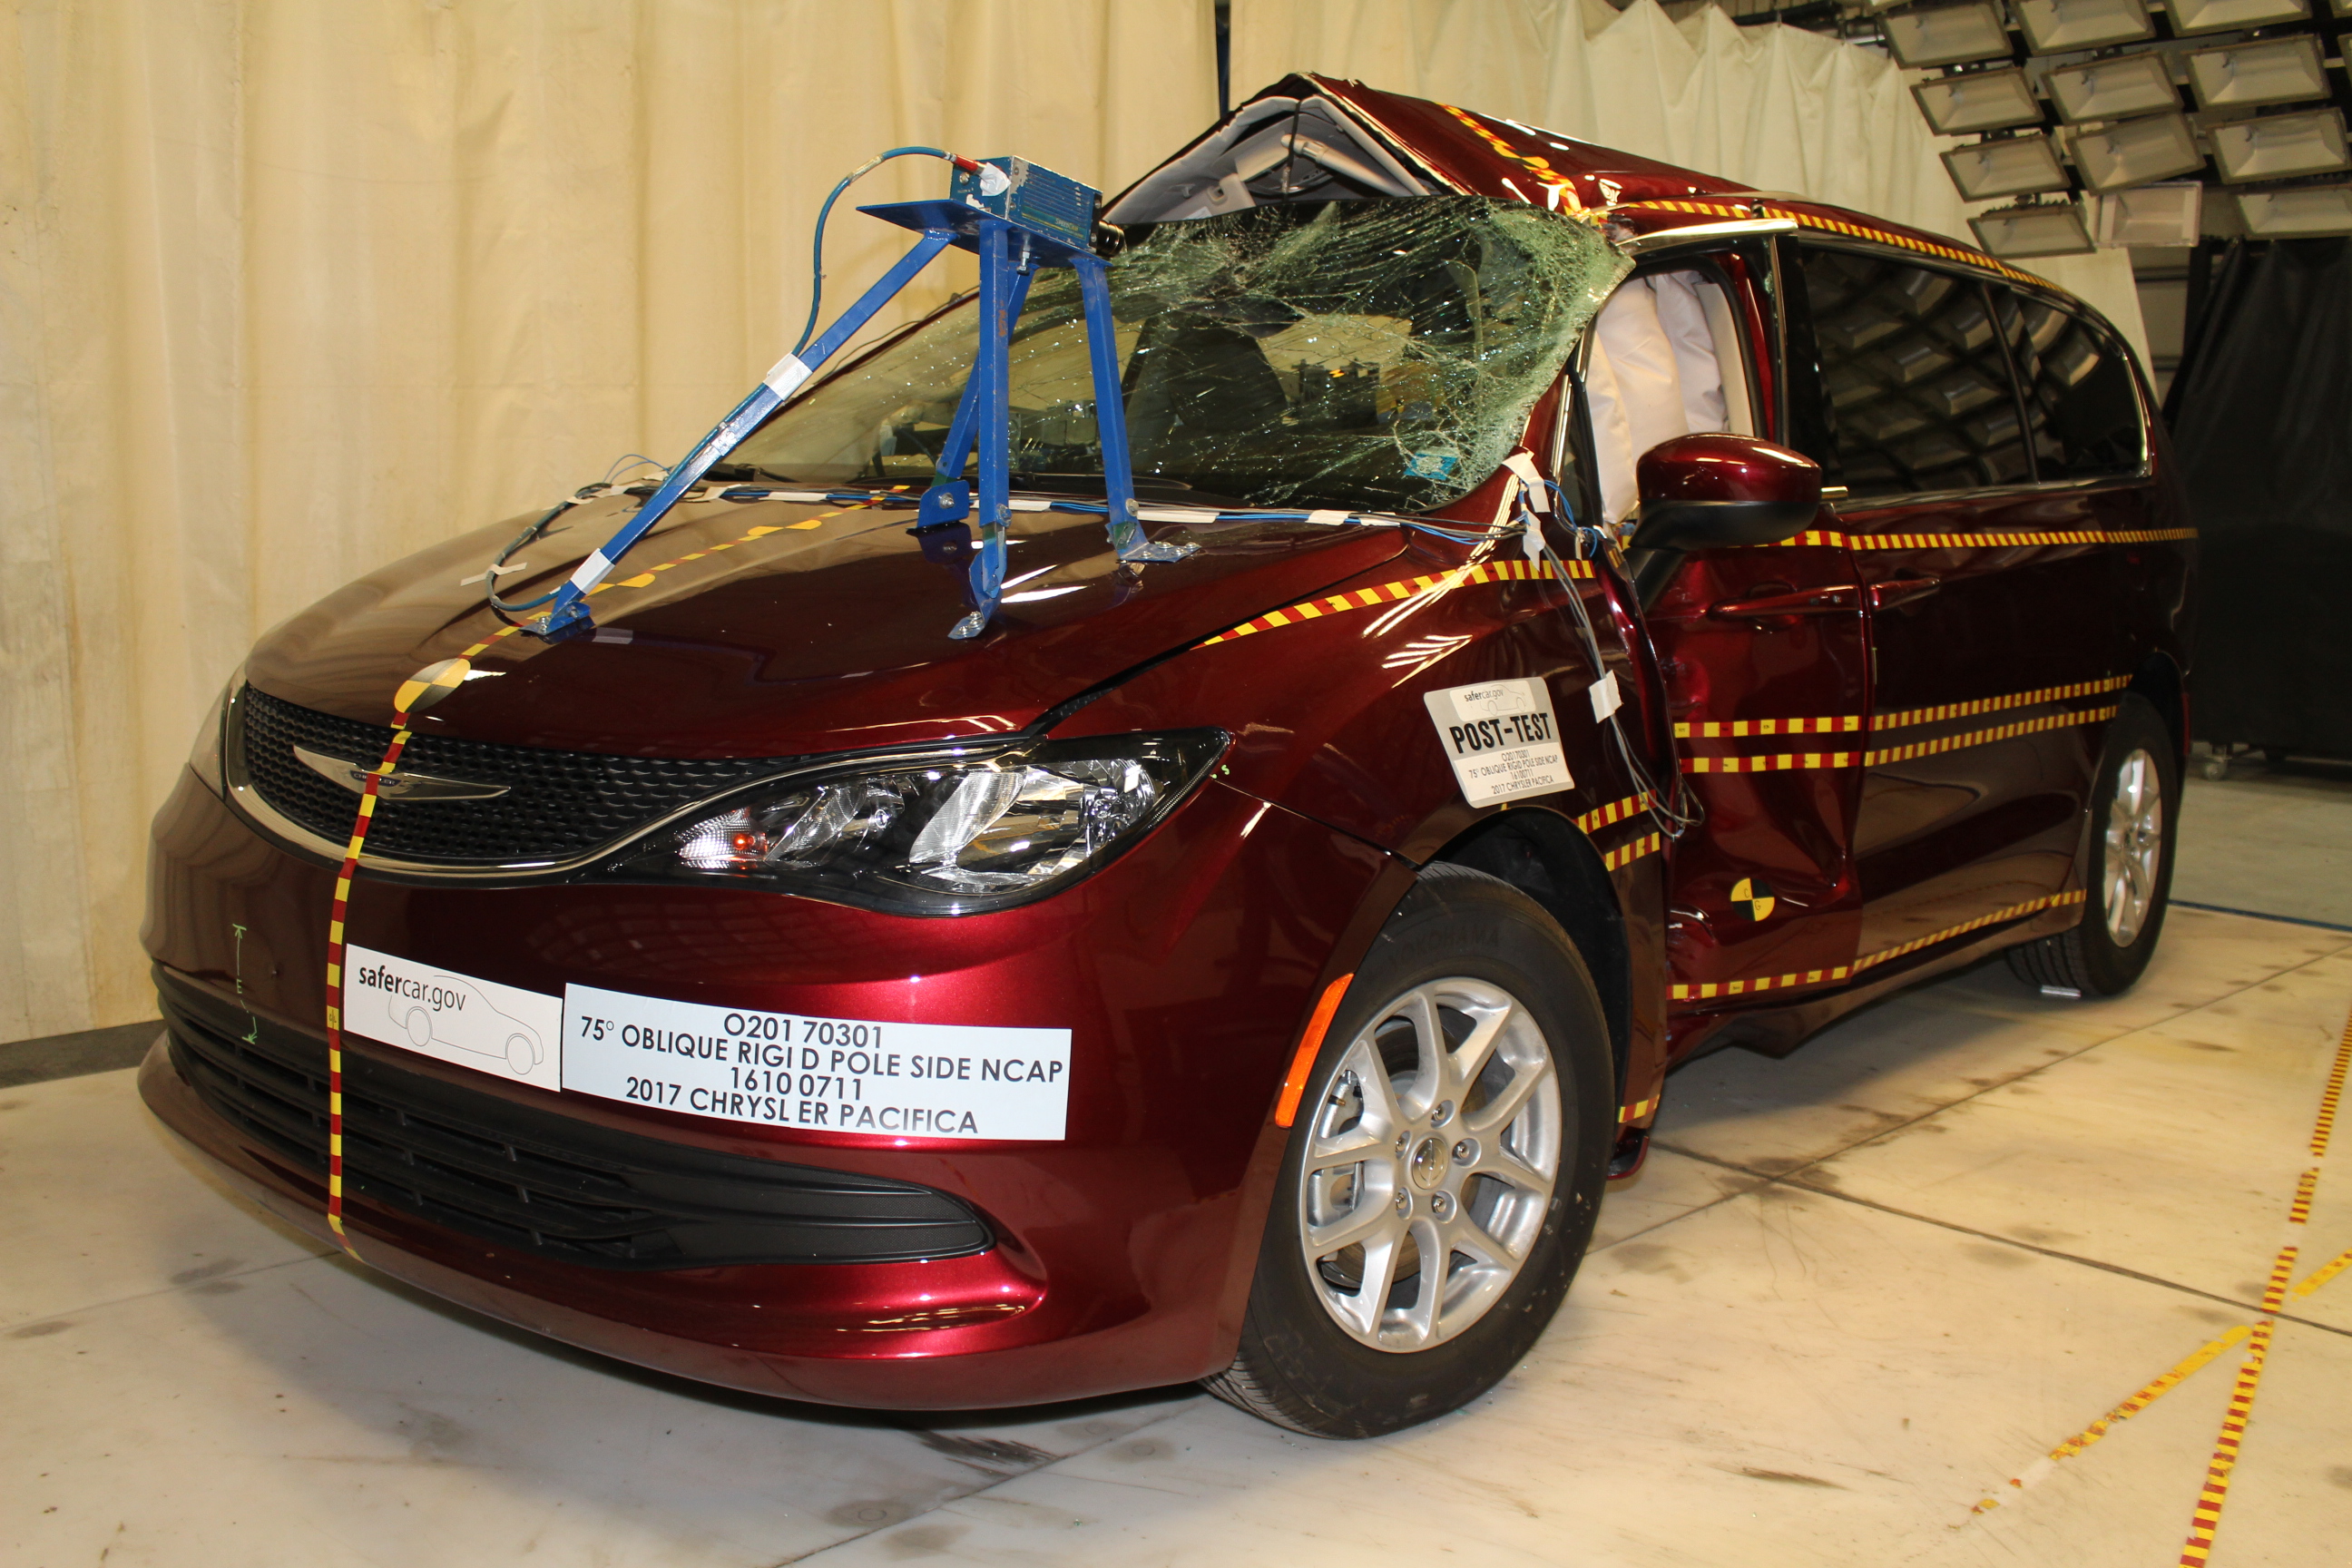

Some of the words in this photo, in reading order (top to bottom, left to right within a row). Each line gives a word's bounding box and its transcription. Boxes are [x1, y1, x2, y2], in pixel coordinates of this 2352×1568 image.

[1464, 689, 1504, 702] safercar.gov
[1448, 712, 1552, 754] POST-TEST
[1480, 763, 1506, 777] OBLIQUE
[1506, 760, 1523, 771] RIGID
[1523, 759, 1534, 769] POLE
[1534, 756, 1545, 766] SIDE
[1545, 754, 1558, 765] NCAP
[1491, 783, 1506, 795] 2017
[1506, 779, 1533, 792] CHRYSLER
[1533, 775, 1554, 786] PACIFICA
[358, 965, 467, 1012] safercar.gov
[621, 1024, 728, 1062] OBLIQUE
[830, 1051, 900, 1076] POLE
[909, 1054, 971, 1080] SIDE
[981, 1058, 1063, 1083] NCAP
[625, 1076, 682, 1106] 2017
[839, 1103, 978, 1133] PACIFICA
